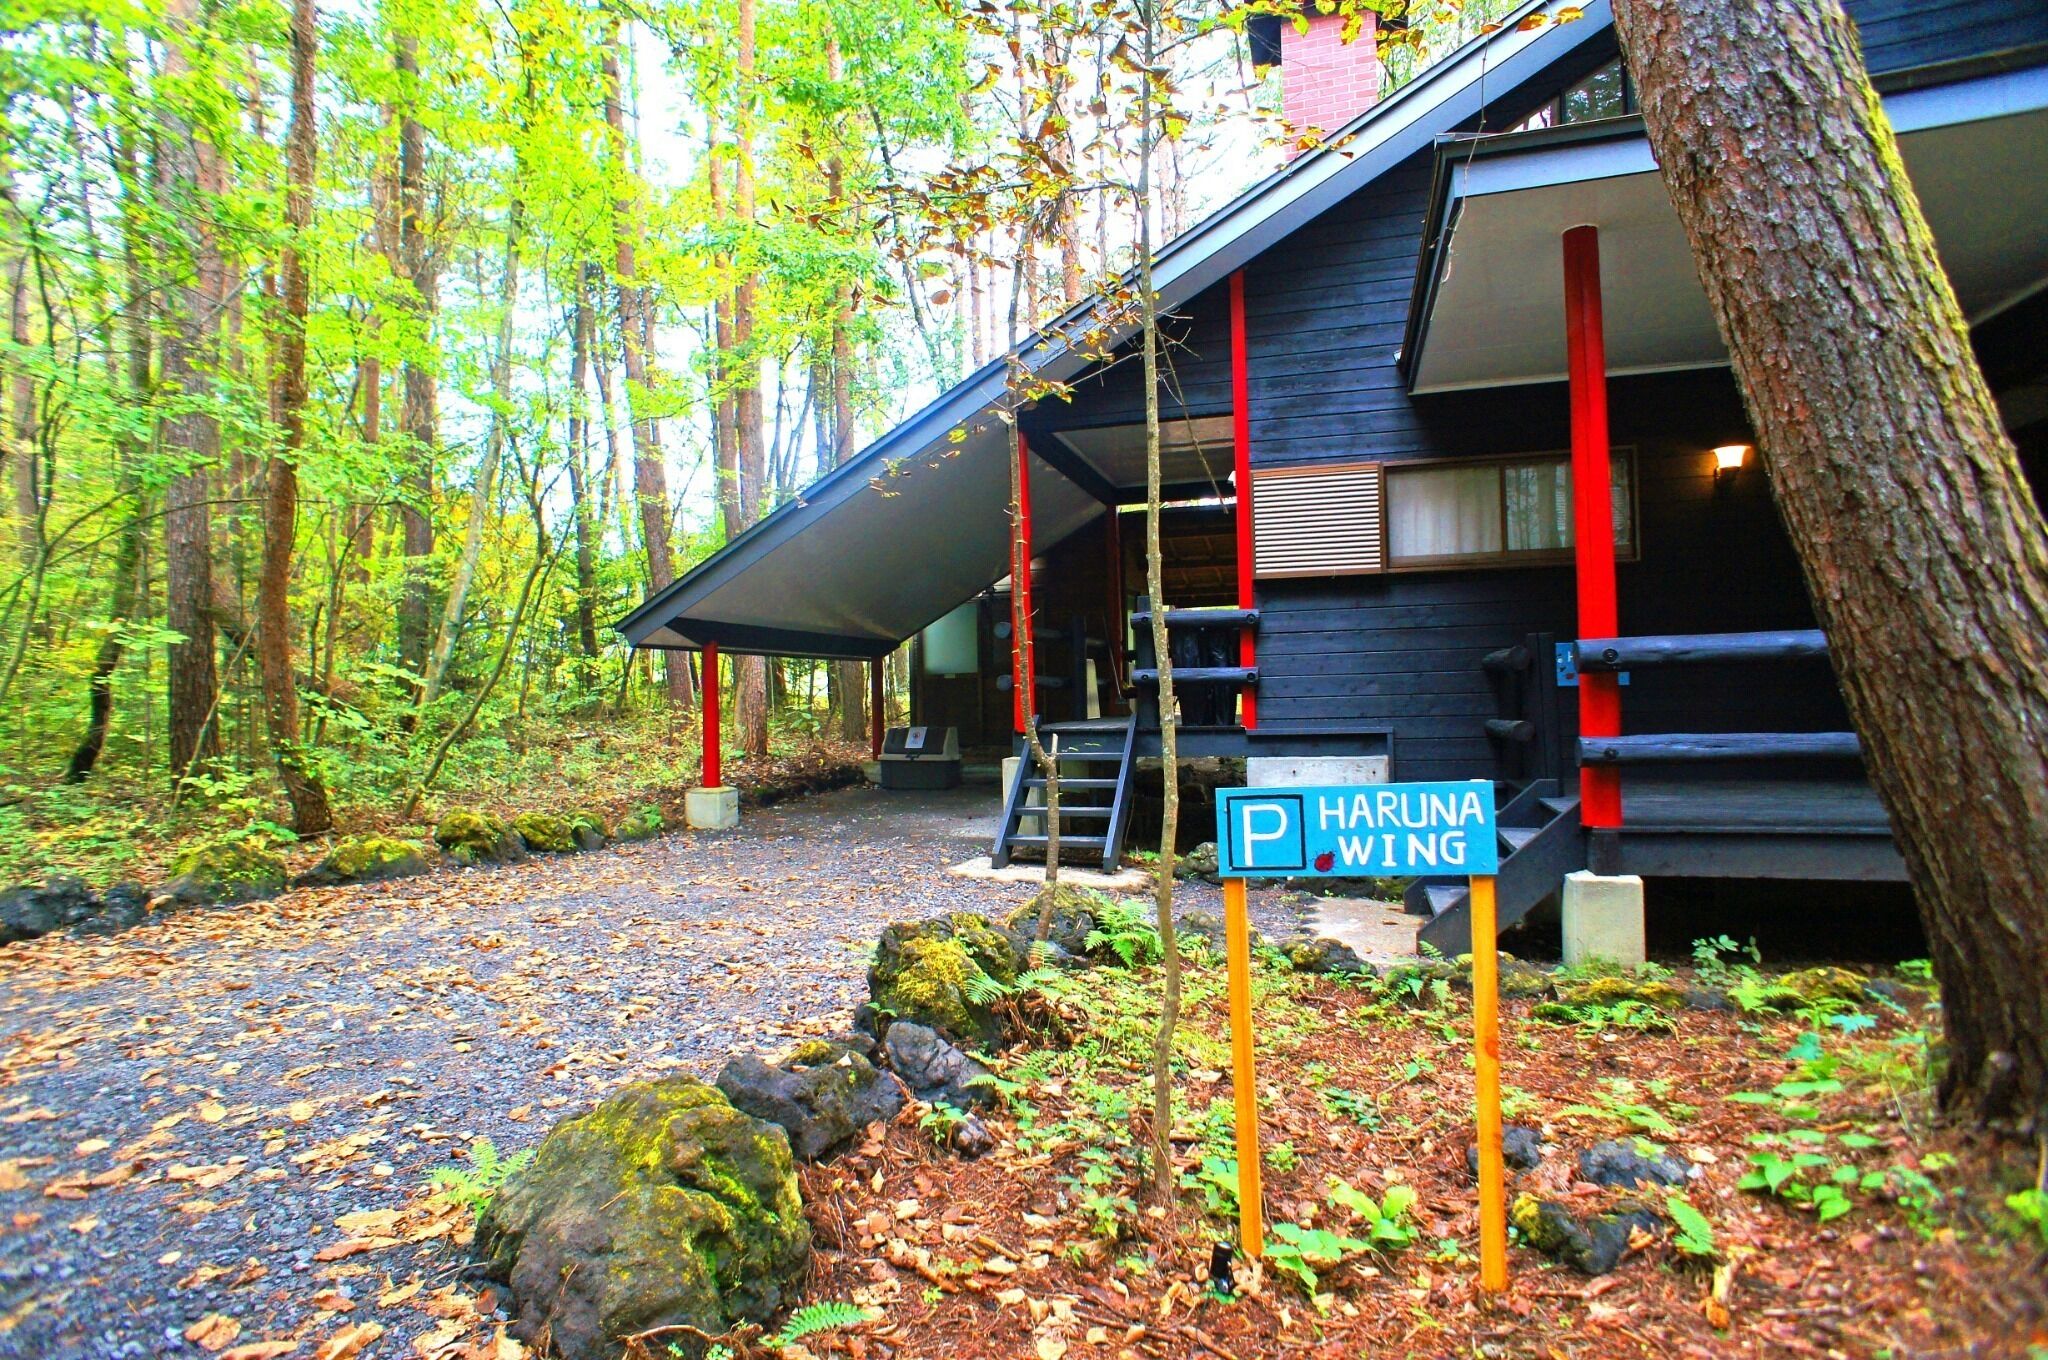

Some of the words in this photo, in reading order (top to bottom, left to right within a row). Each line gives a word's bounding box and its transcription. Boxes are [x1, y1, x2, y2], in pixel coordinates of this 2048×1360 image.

[1318, 791, 1484, 830] HARUNA
[1242, 804, 1288, 866] P
[1338, 831, 1467, 867] WING
